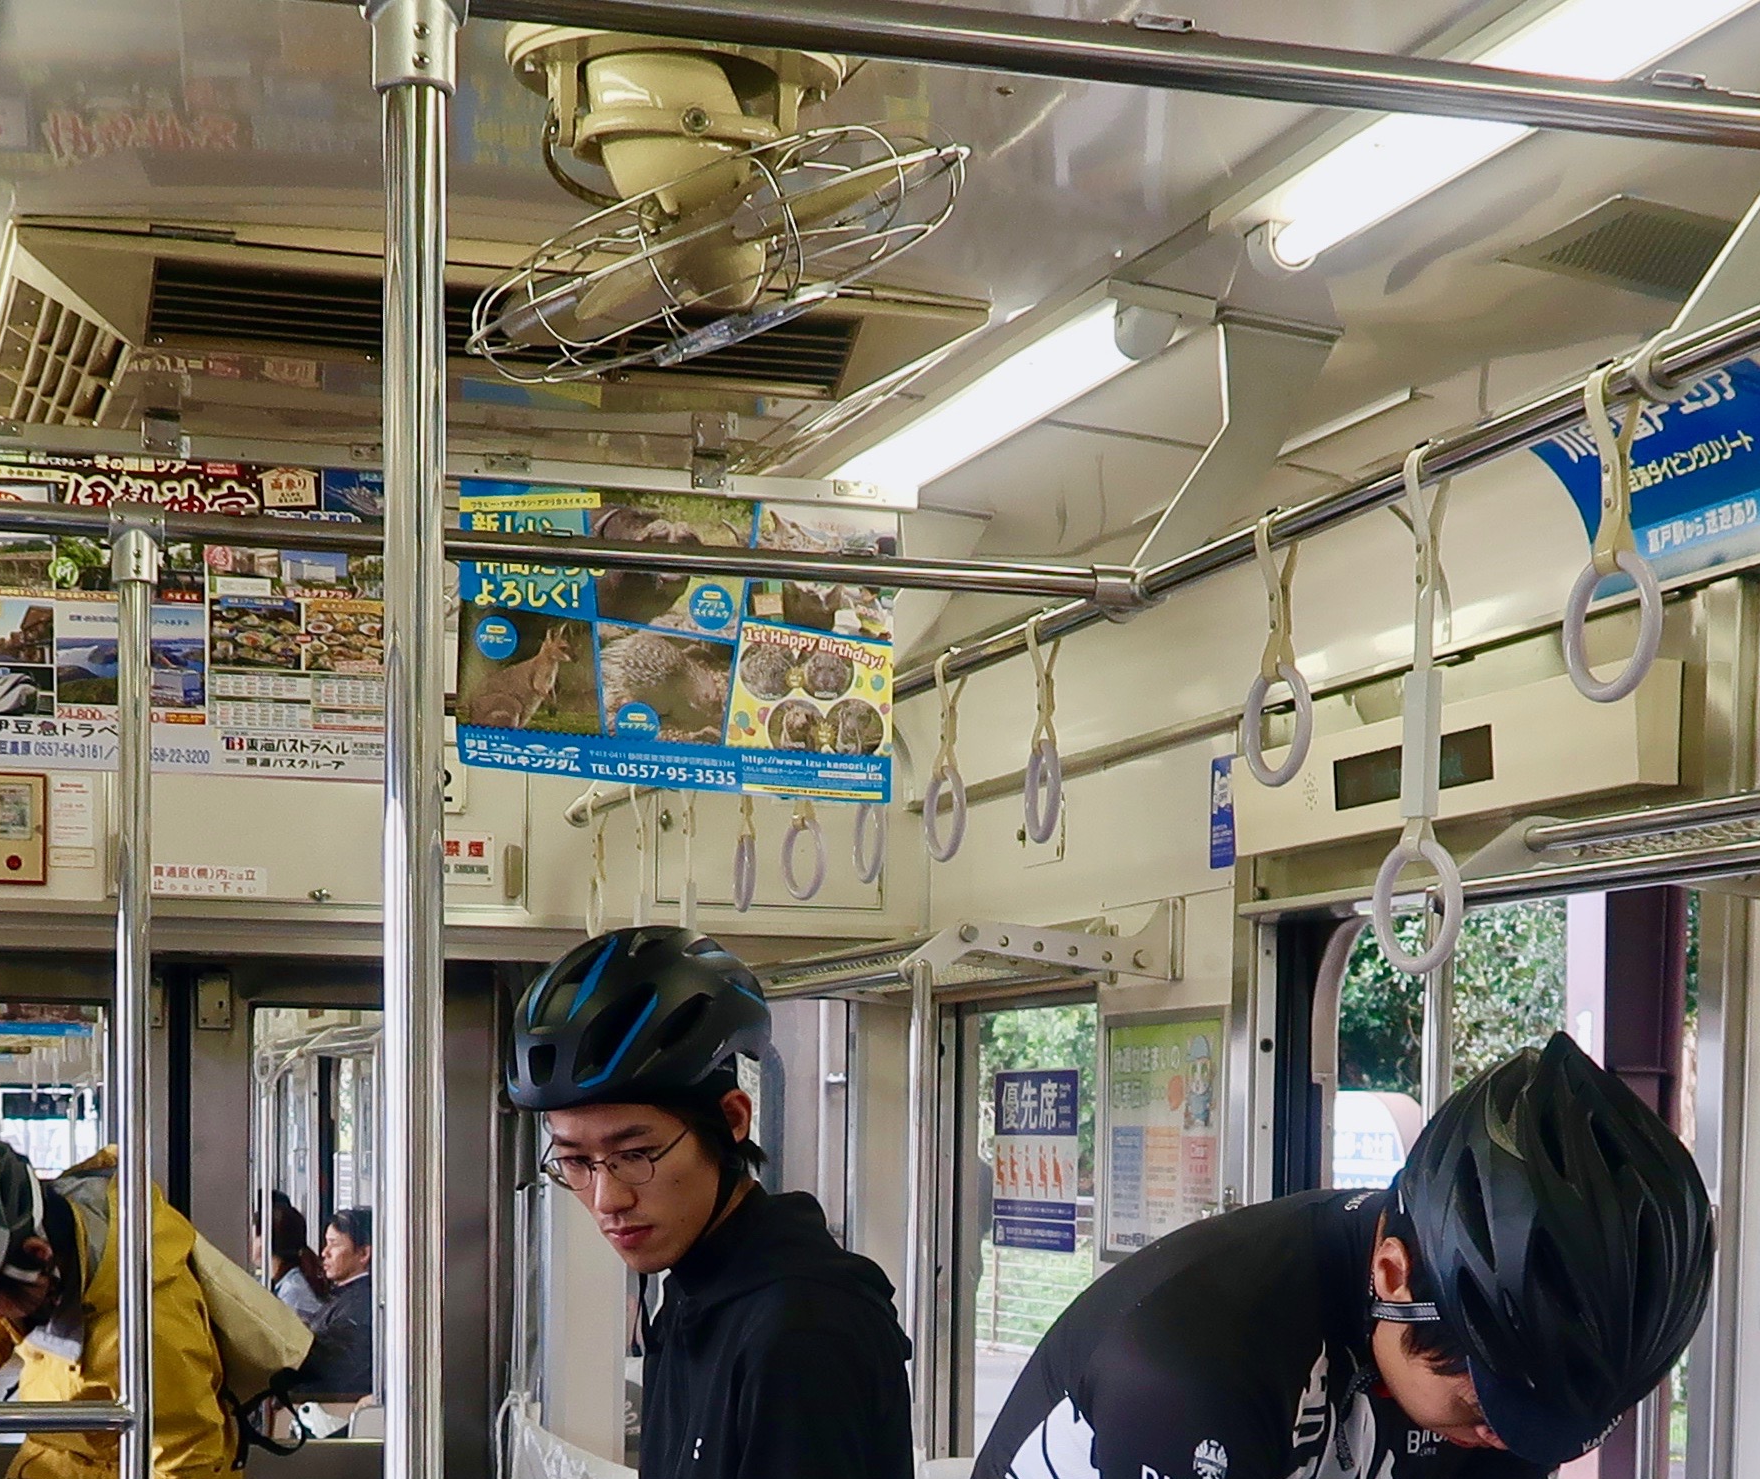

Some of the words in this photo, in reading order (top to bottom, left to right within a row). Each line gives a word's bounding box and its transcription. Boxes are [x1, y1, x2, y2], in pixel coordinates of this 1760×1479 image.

[769, 630, 818, 654] Happy
[818, 641, 886, 670] Birthday!
[1002, 1079, 1058, 1130] 優先席
